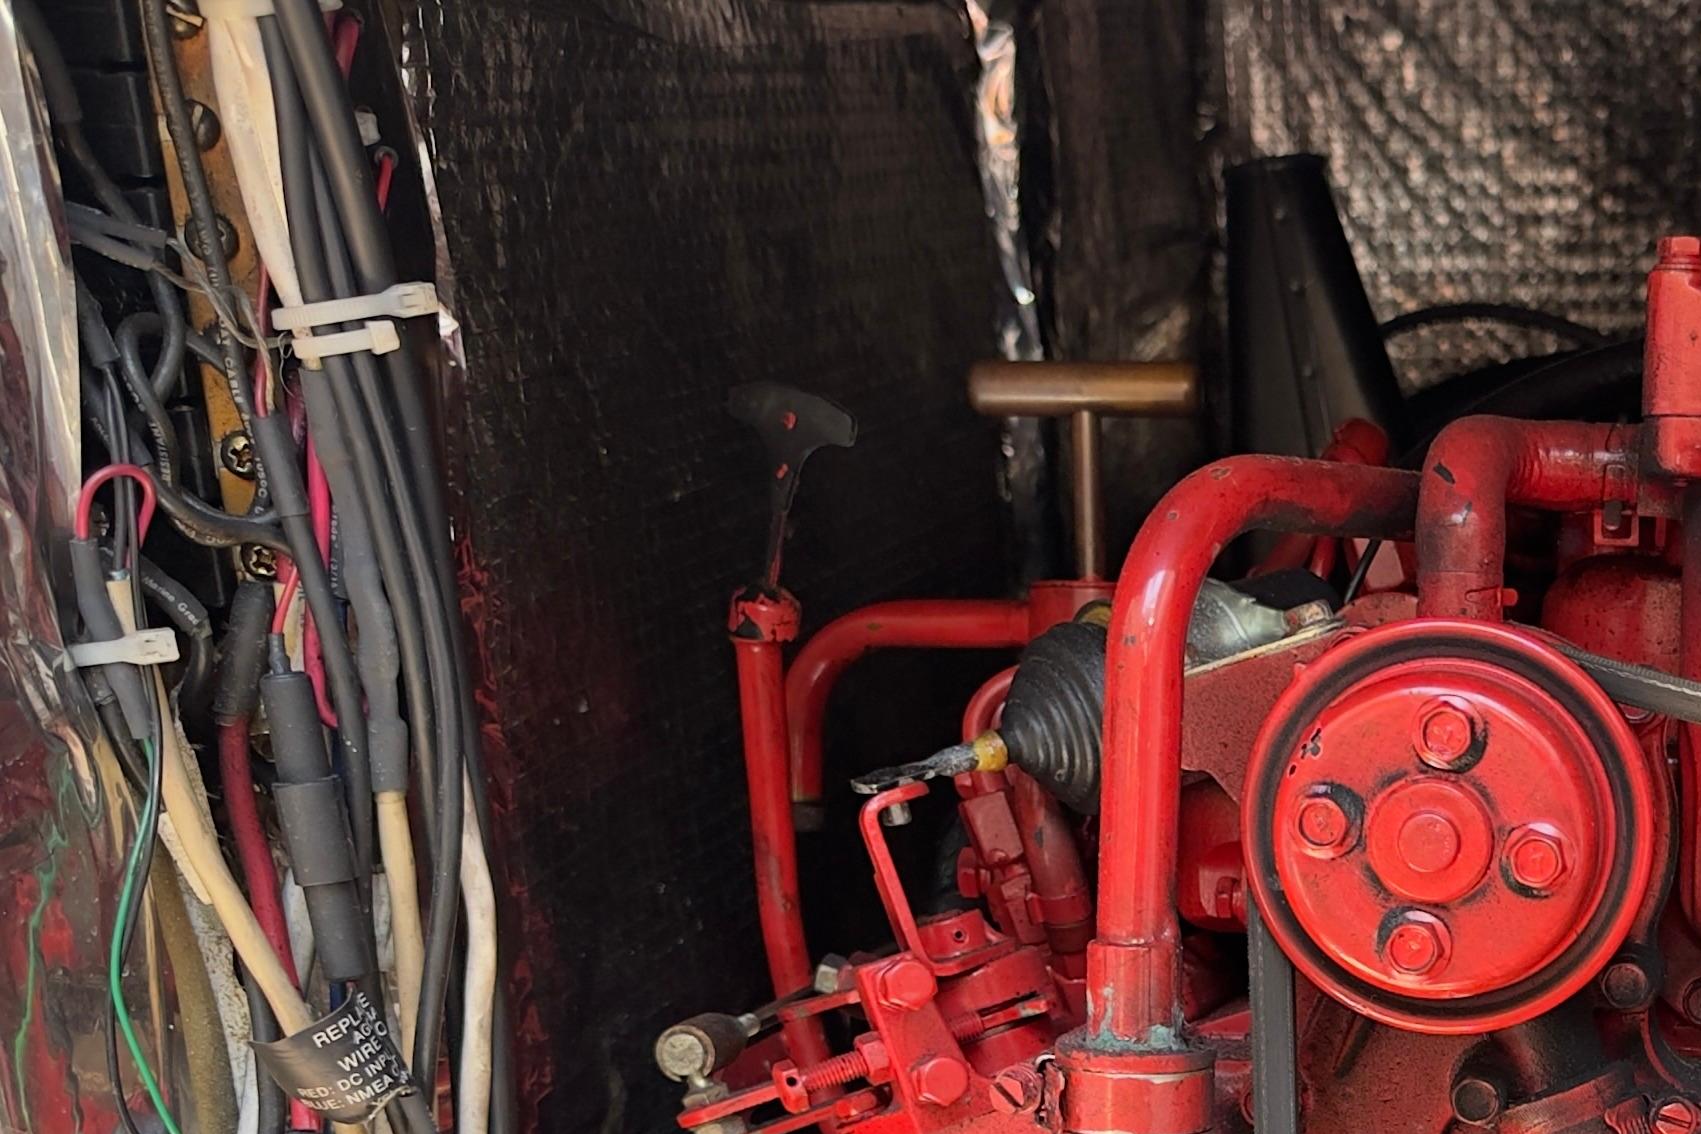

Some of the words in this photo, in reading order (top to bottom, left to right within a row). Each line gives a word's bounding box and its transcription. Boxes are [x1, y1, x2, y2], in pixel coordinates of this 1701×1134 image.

[337, 1037, 382, 1072] WIRE
[336, 1073, 364, 1092] DC
[348, 1074, 394, 1106] NMEA
